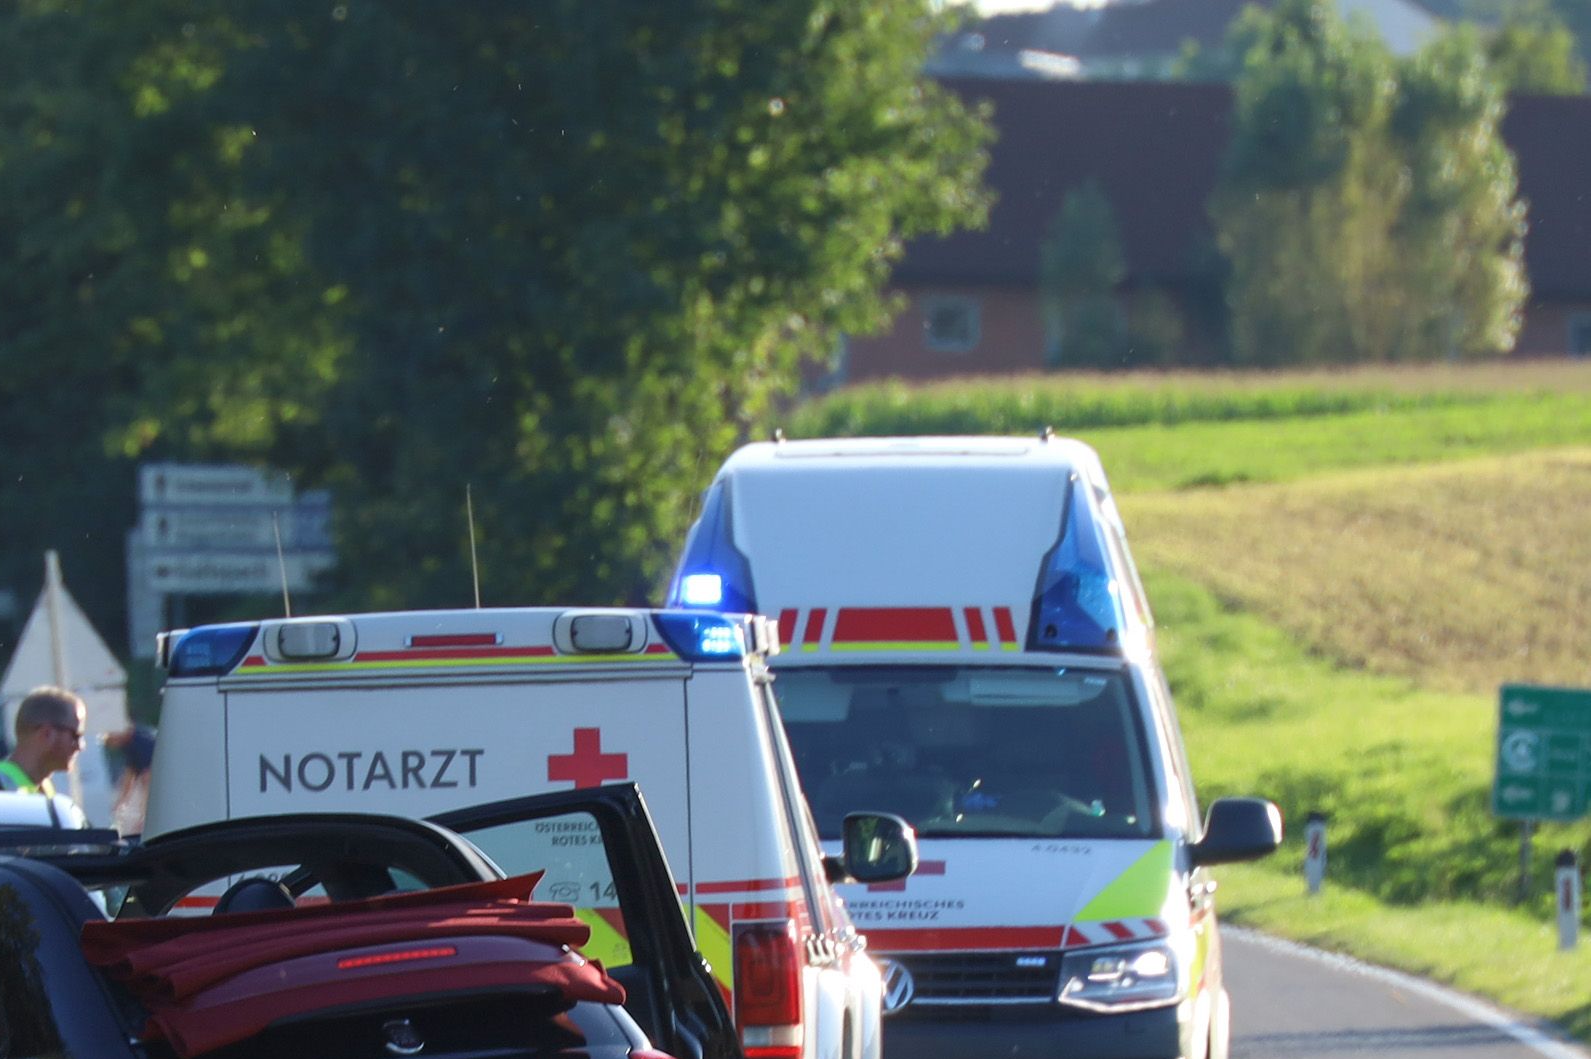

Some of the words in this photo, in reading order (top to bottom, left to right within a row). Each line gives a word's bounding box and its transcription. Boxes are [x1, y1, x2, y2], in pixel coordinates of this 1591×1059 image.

[260, 749, 484, 793] NOTARZT
[552, 834, 587, 847] ROTES
[848, 899, 965, 910] RREICHISCHES
[887, 910, 940, 920] KREUZ
